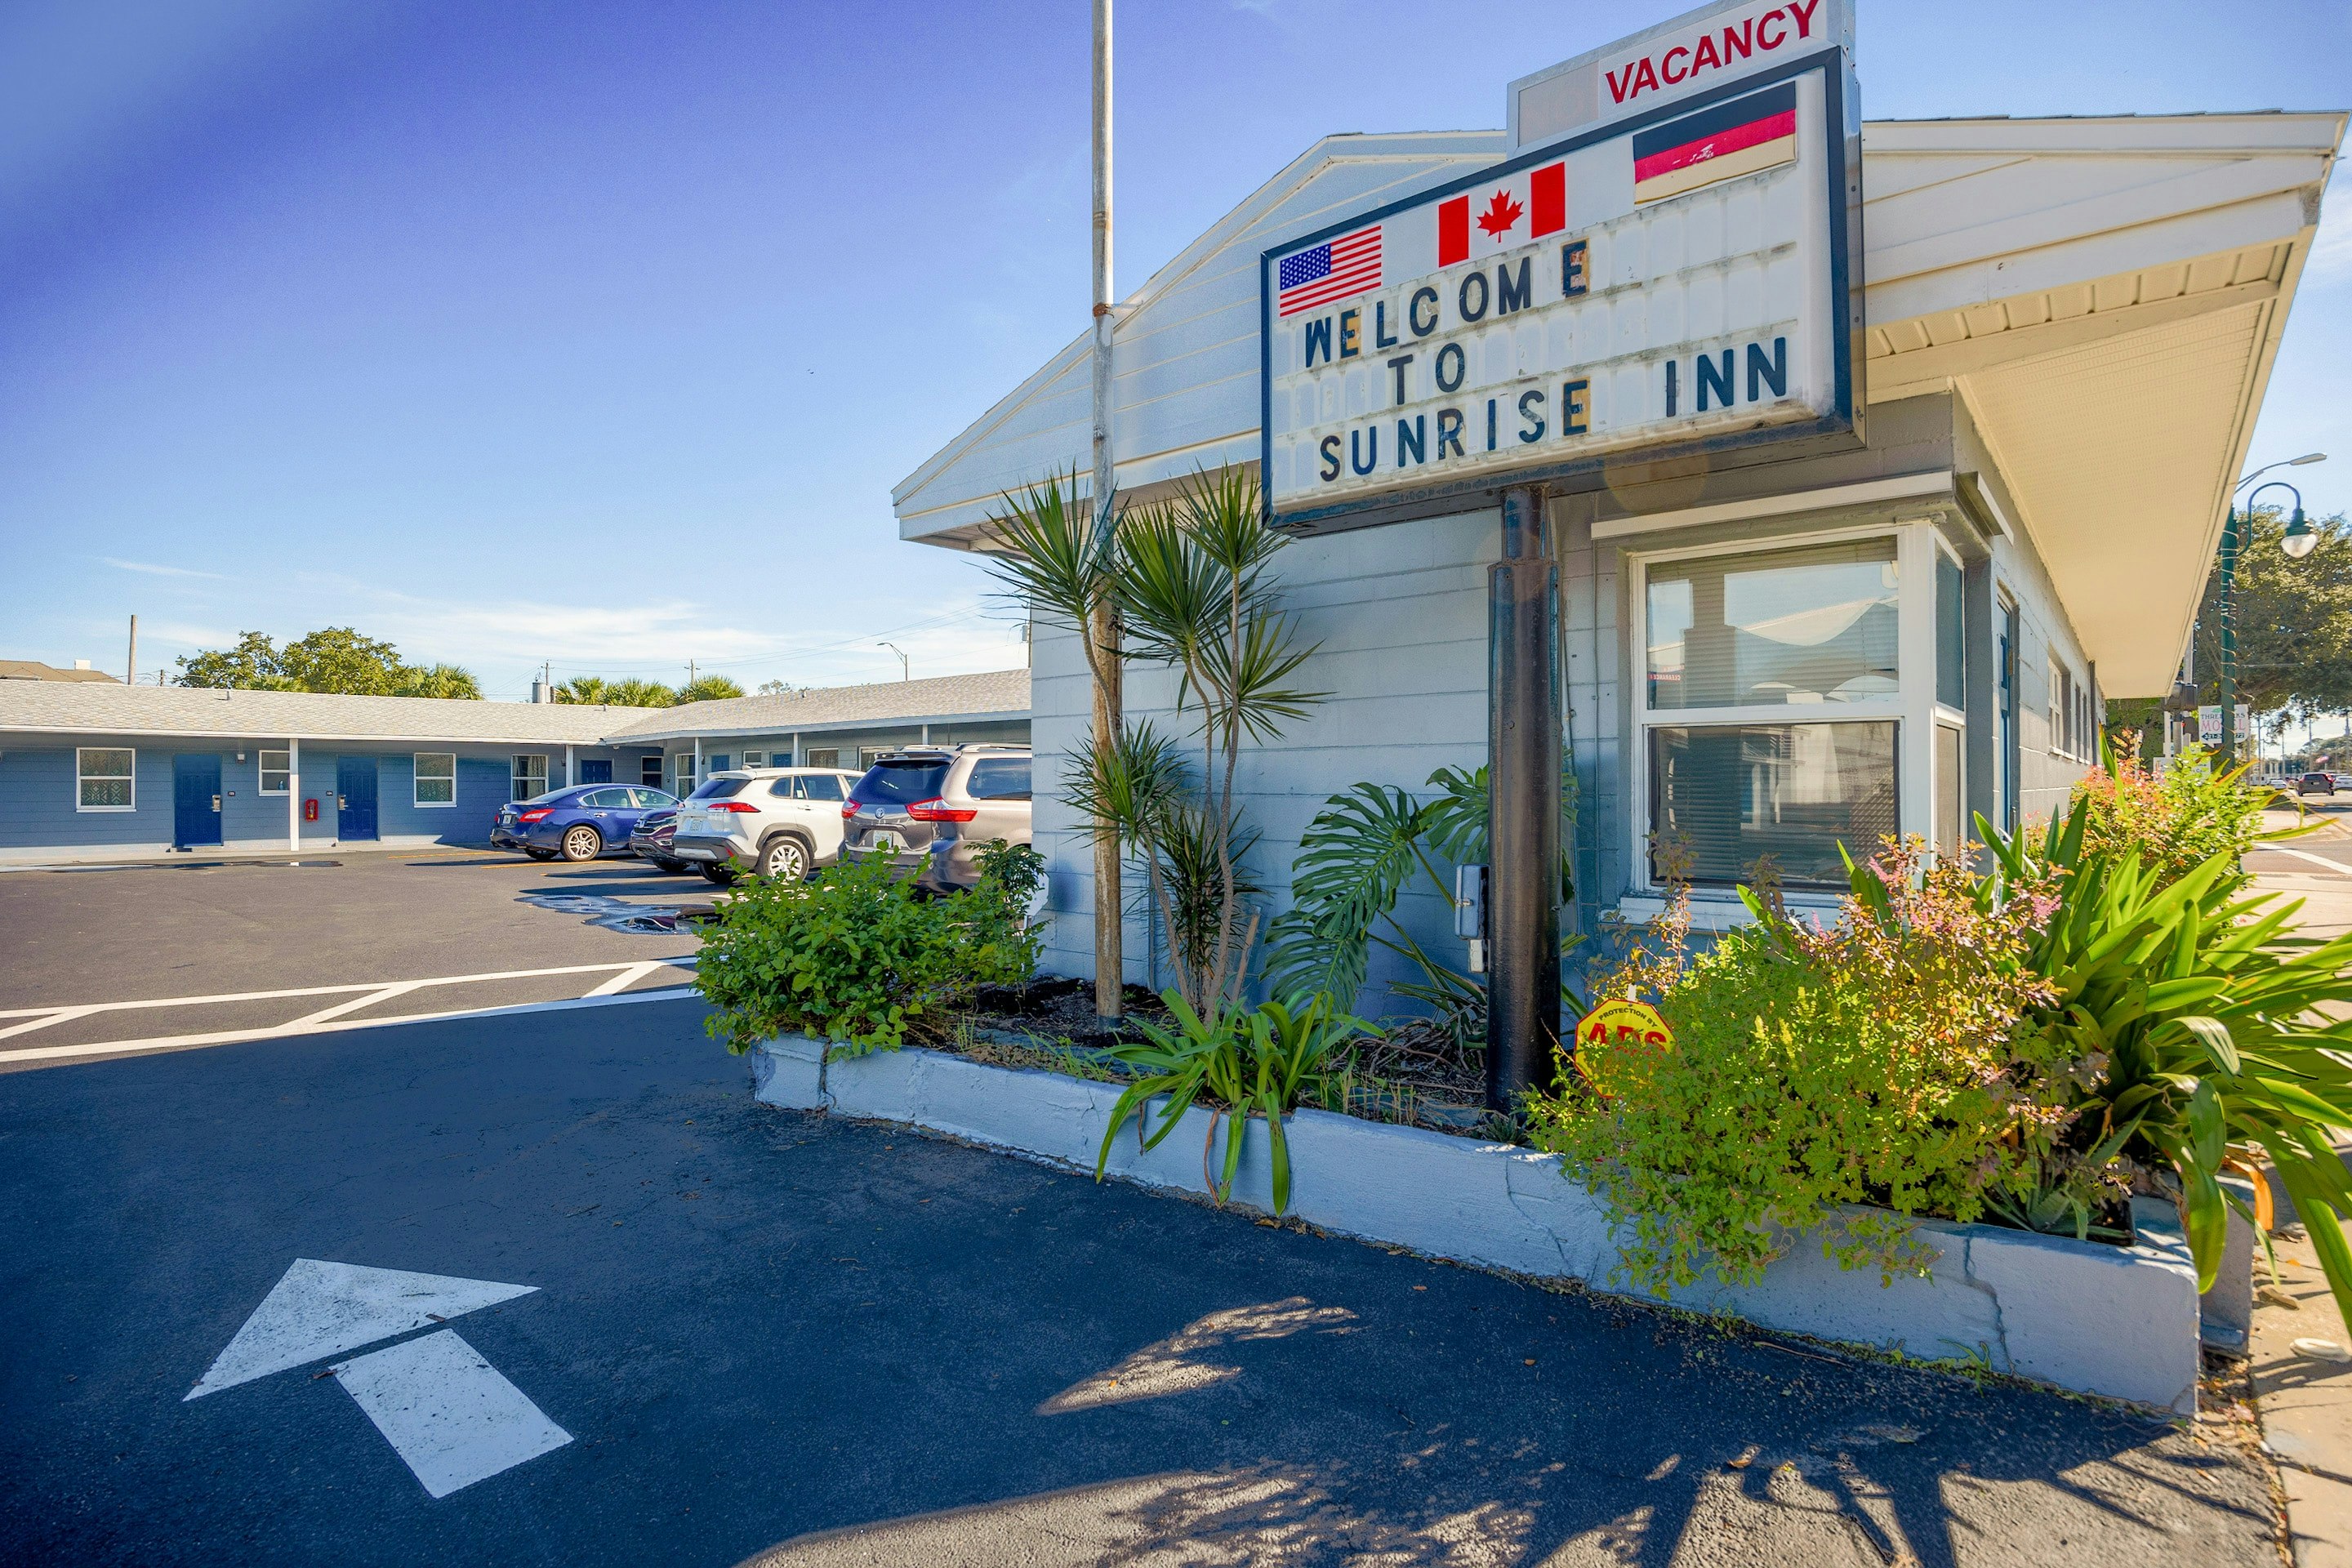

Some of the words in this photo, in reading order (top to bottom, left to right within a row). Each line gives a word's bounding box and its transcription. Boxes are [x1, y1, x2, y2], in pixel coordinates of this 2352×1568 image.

[1604, 0, 1820, 105] VACANCY
[1305, 239, 1588, 368] WELCOME
[1320, 379, 1588, 482] SUNRISE
[1666, 336, 1787, 418] INN
[1388, 342, 1466, 405] TO
[2201, 719, 2246, 732] MOL
[1598, 1007, 1647, 1021] PROTECTION
[1646, 1018, 1658, 1027] BY
